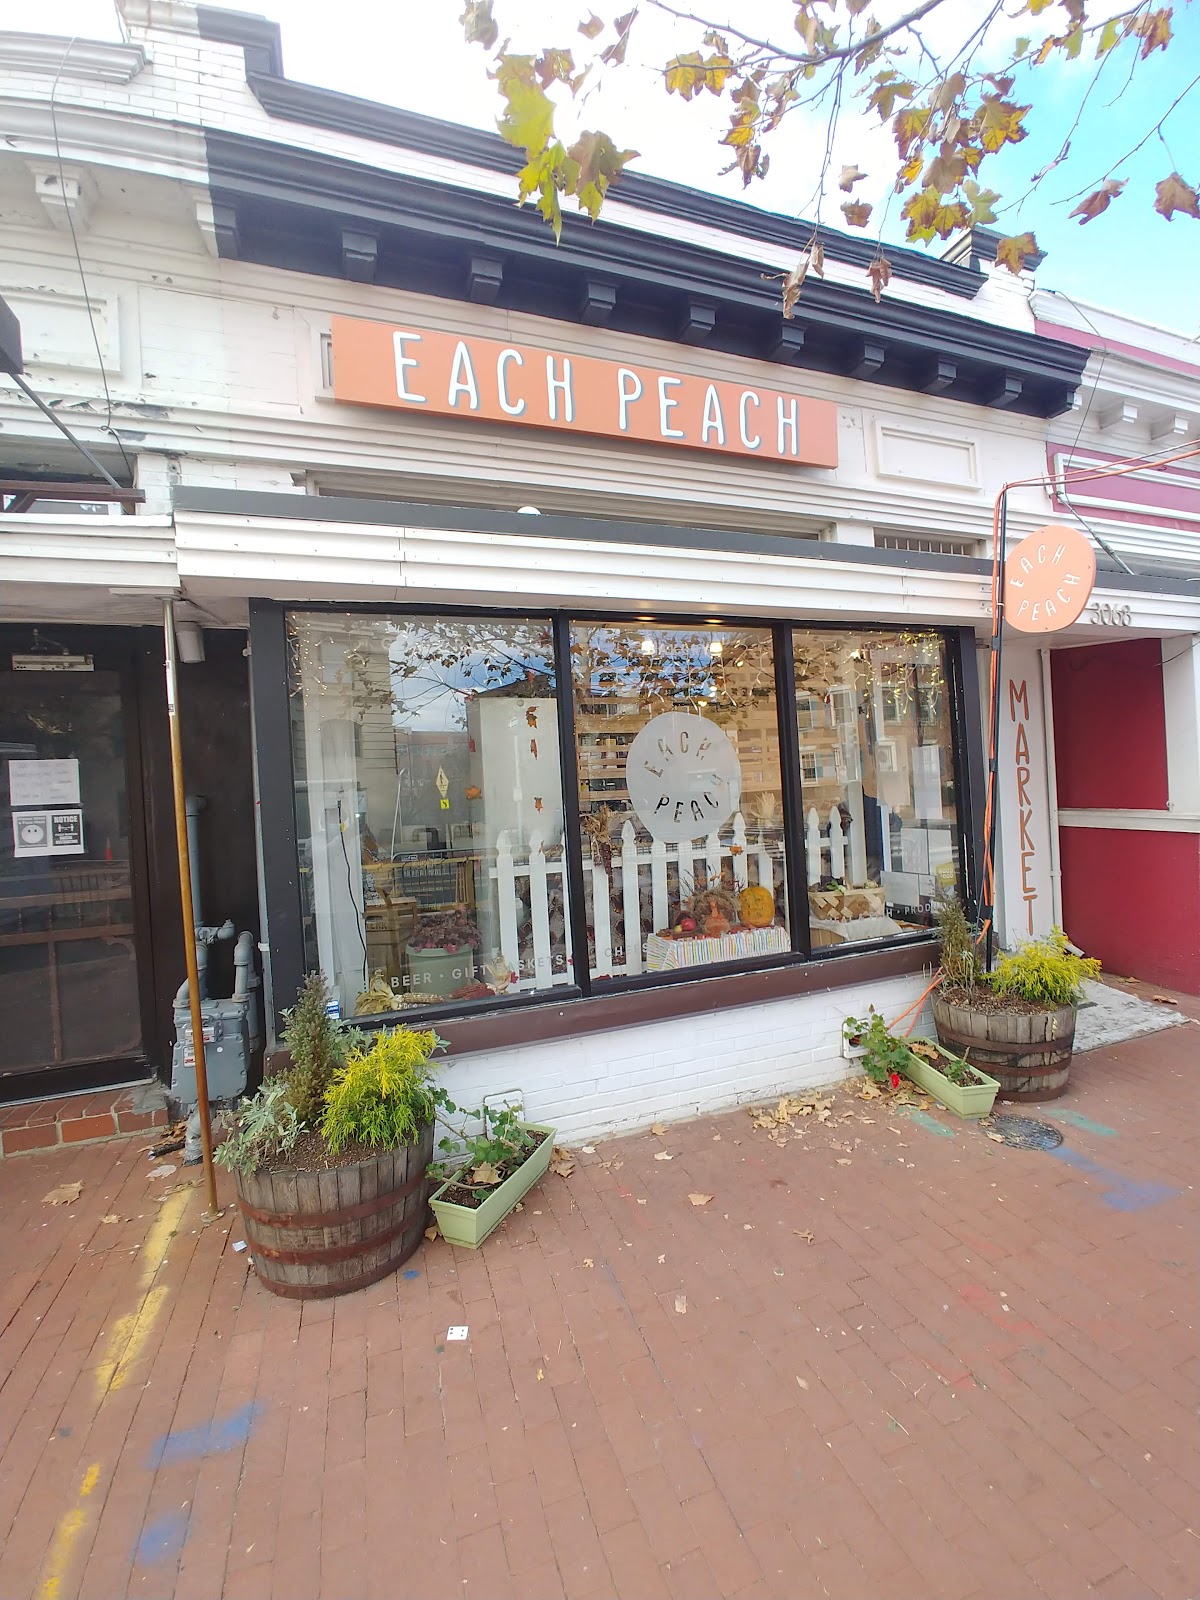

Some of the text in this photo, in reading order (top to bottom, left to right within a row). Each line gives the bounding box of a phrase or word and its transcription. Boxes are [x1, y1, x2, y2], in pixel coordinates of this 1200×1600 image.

[392, 330, 798, 456] EACH PEACH
[1009, 544, 1066, 589] EACH
[1016, 573, 1081, 621] PEACH
[1089, 601, 1133, 627] 3068
[643, 731, 712, 778] EACH
[53, 815, 78, 824] NOTICE
[1008, 678, 1038, 937] MARKET
[391, 972, 432, 988] BEER
[452, 964, 486, 980] GIFT
